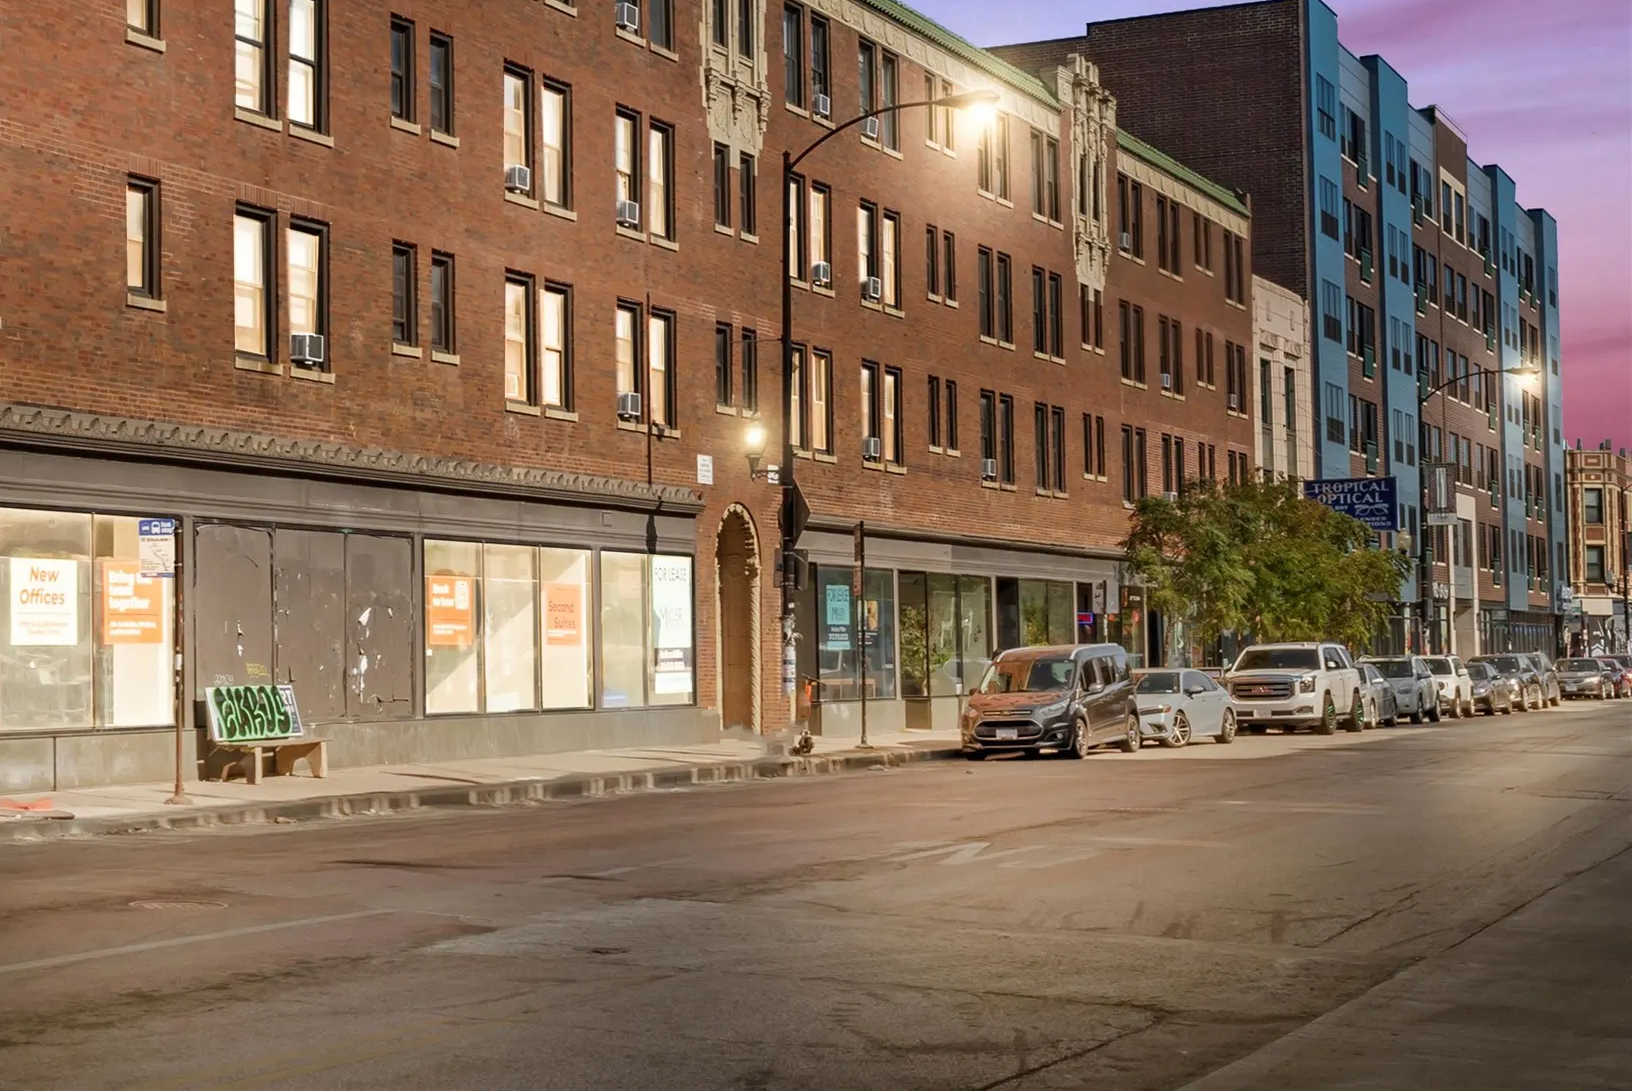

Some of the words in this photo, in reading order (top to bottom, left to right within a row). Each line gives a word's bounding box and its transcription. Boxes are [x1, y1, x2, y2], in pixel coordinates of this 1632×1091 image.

[1312, 480, 1389, 494] TROPICAL
[1317, 492, 1384, 505] OPTICAL
[30, 565, 60, 582] New
[19, 588, 65, 606] Offices
[548, 600, 575, 613] Second
